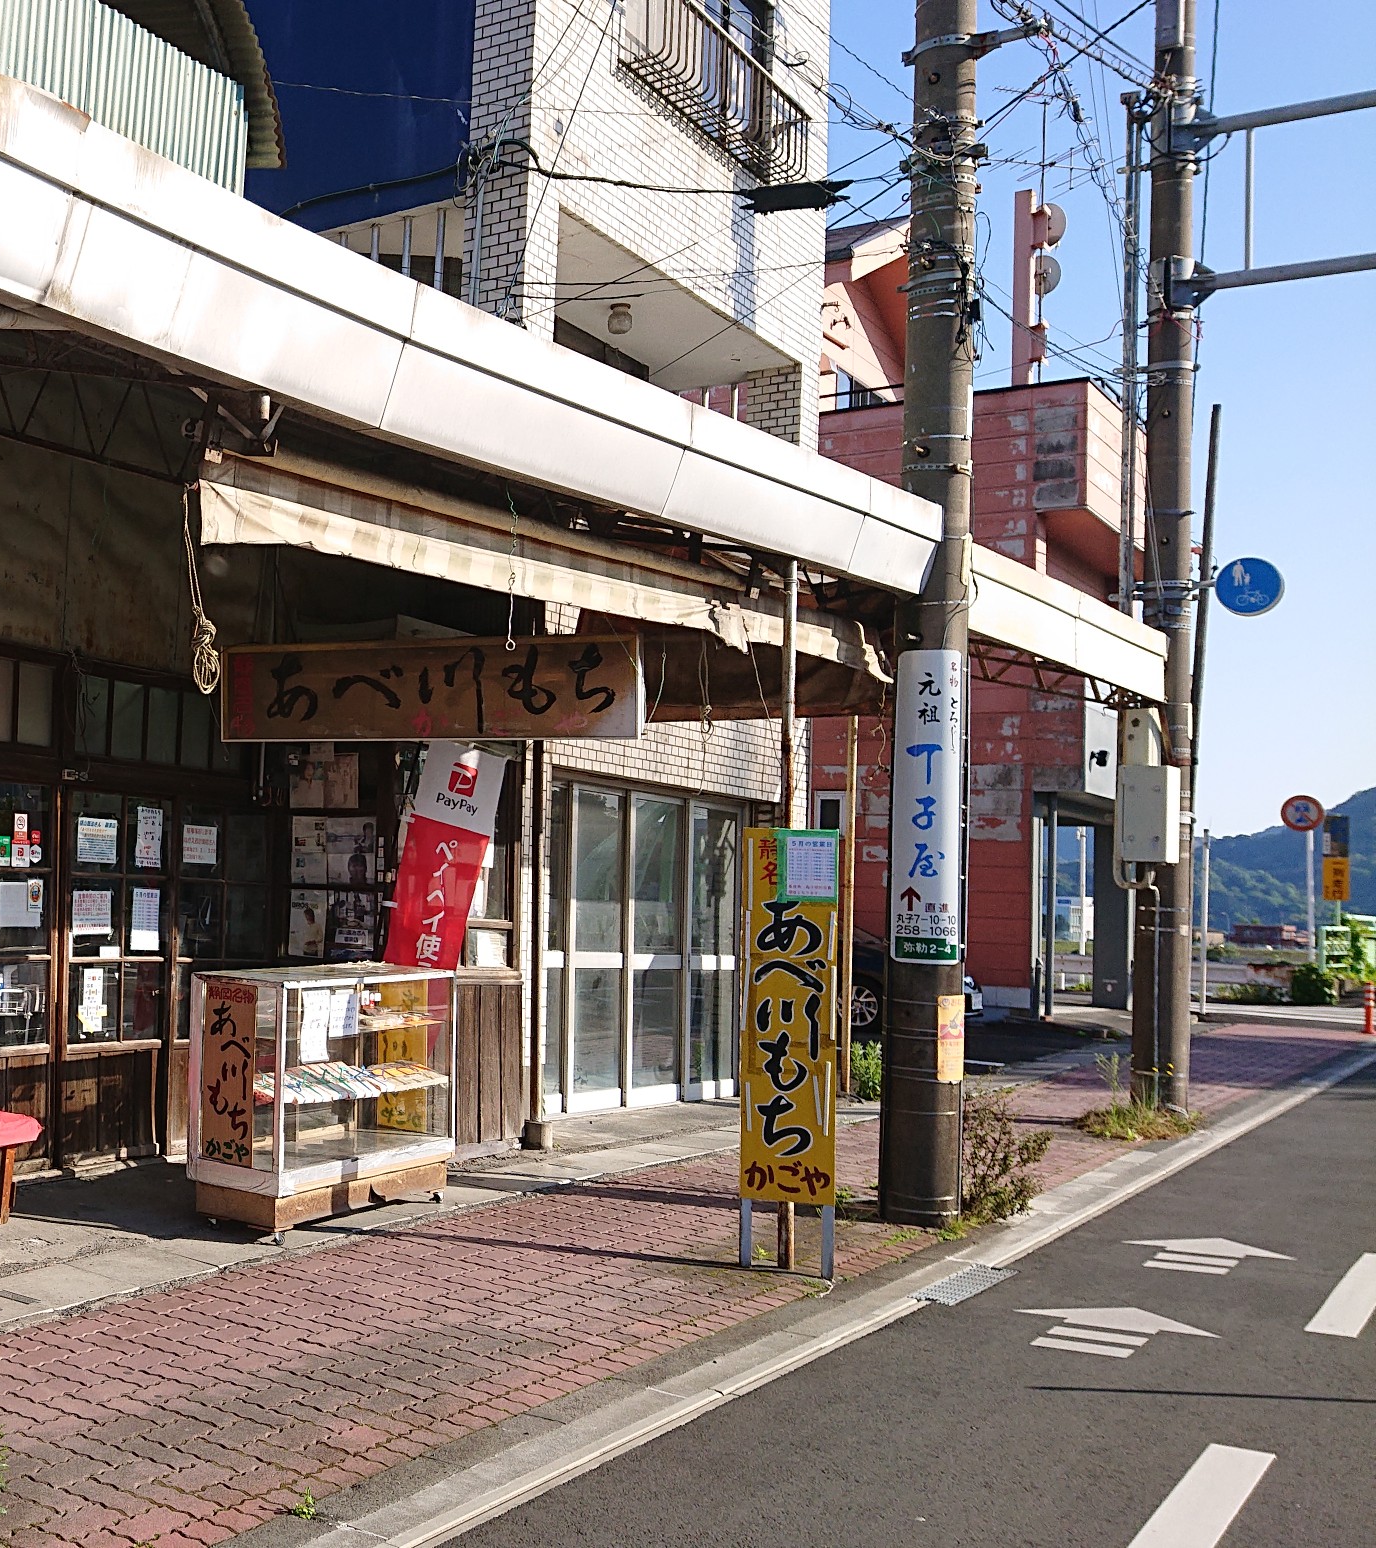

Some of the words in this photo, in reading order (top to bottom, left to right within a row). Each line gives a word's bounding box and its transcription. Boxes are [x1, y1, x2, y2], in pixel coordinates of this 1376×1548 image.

[265, 643, 617, 735] あべ川もち
[917, 671, 942, 725] 元祖
[435, 792, 478, 816] PayPay
[906, 742, 946, 879] 丁子屋
[895, 924, 957, 937] 258-1066
[903, 941, 952, 955] 弥勒2-4
[753, 899, 828, 1158] あべ川もち
[208, 1000, 252, 1141] あべ川もち
[205, 1137, 250, 1162] かごや
[744, 1160, 832, 1197] かごや
